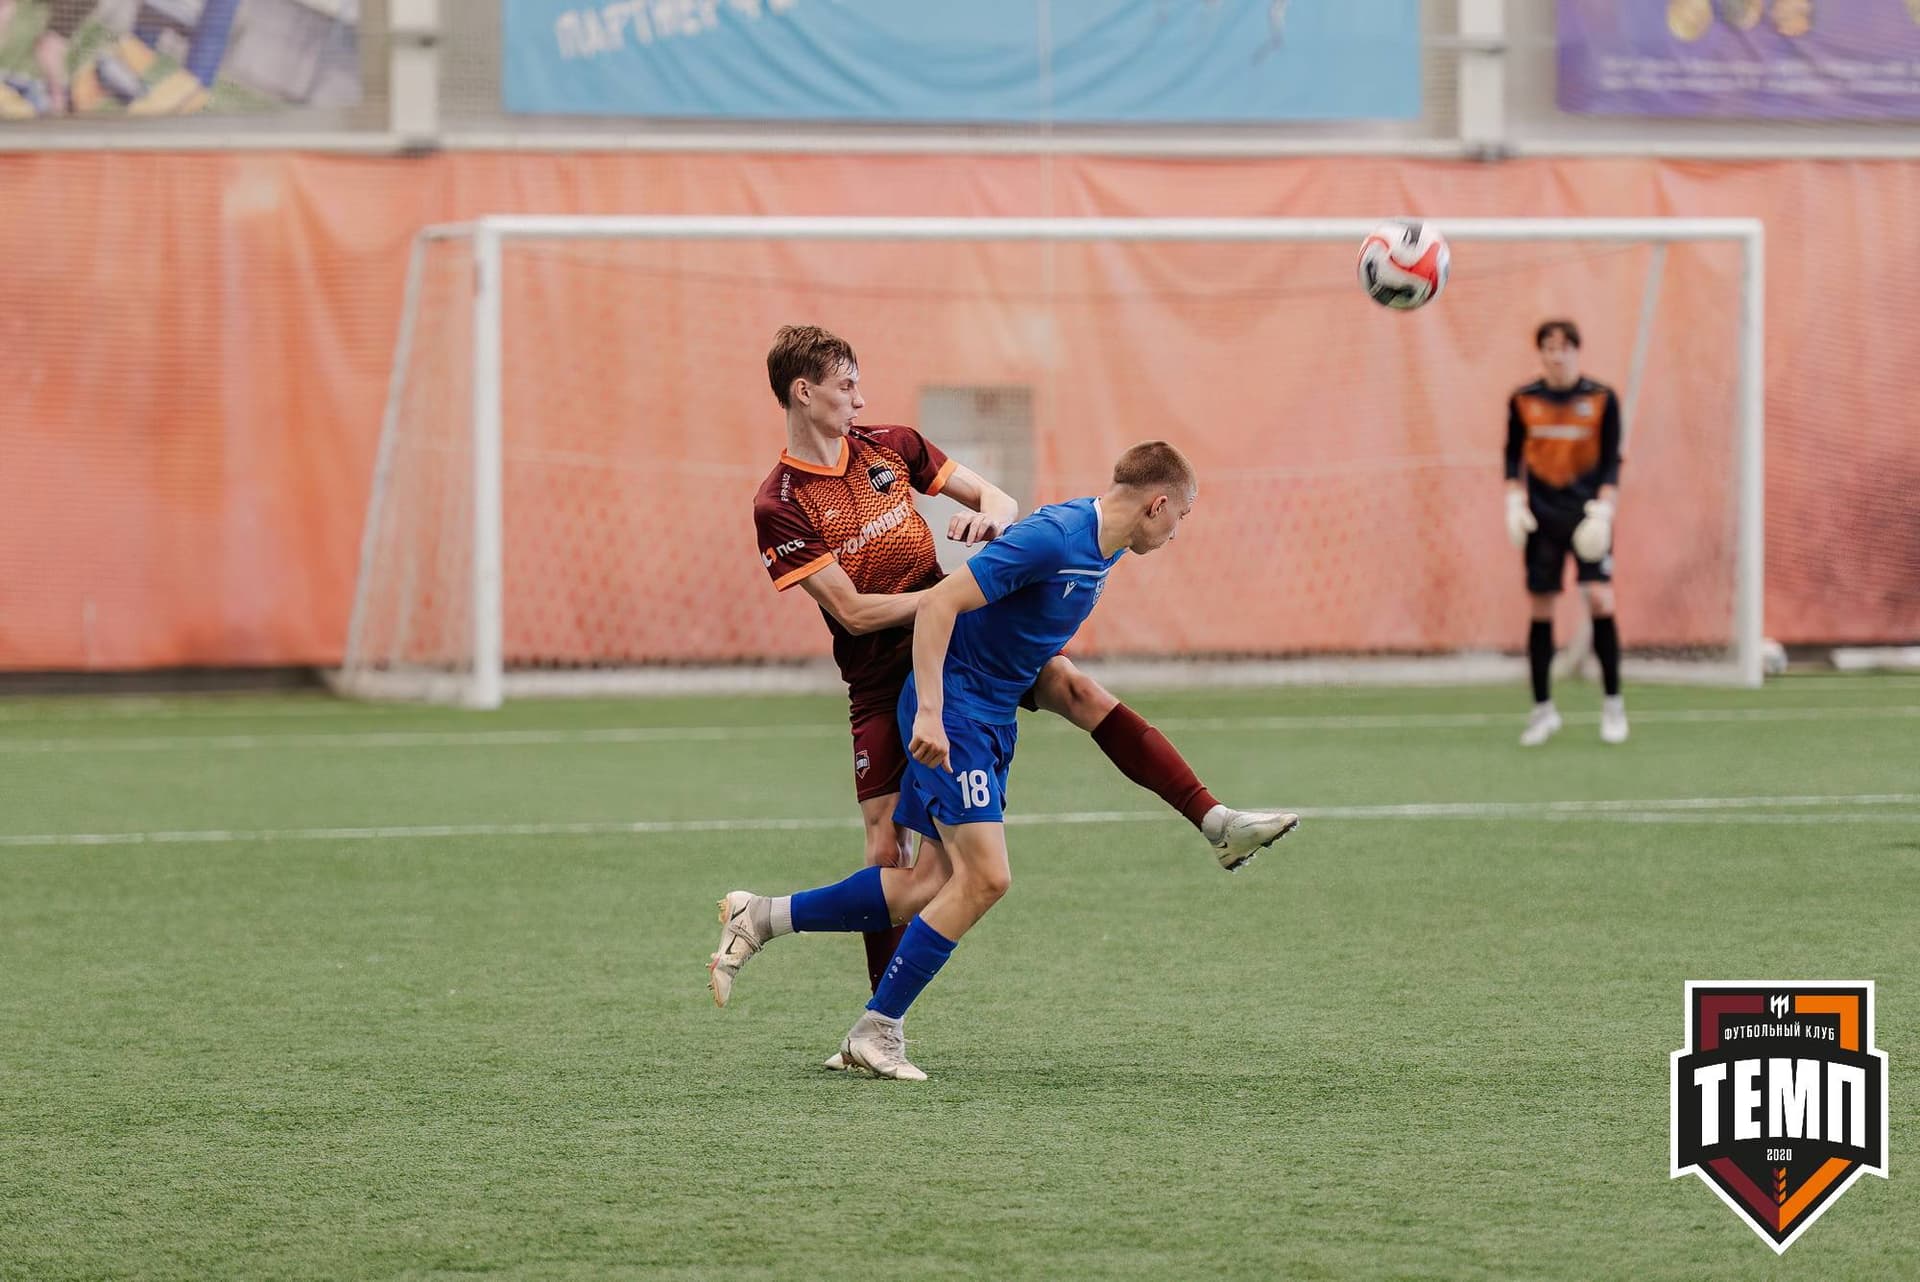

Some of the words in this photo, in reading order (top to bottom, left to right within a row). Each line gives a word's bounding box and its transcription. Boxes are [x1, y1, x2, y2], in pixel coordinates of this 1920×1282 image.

[871, 470, 896, 490] ТЕМП
[776, 538, 806, 557] ПСБ
[956, 769, 990, 809] 18
